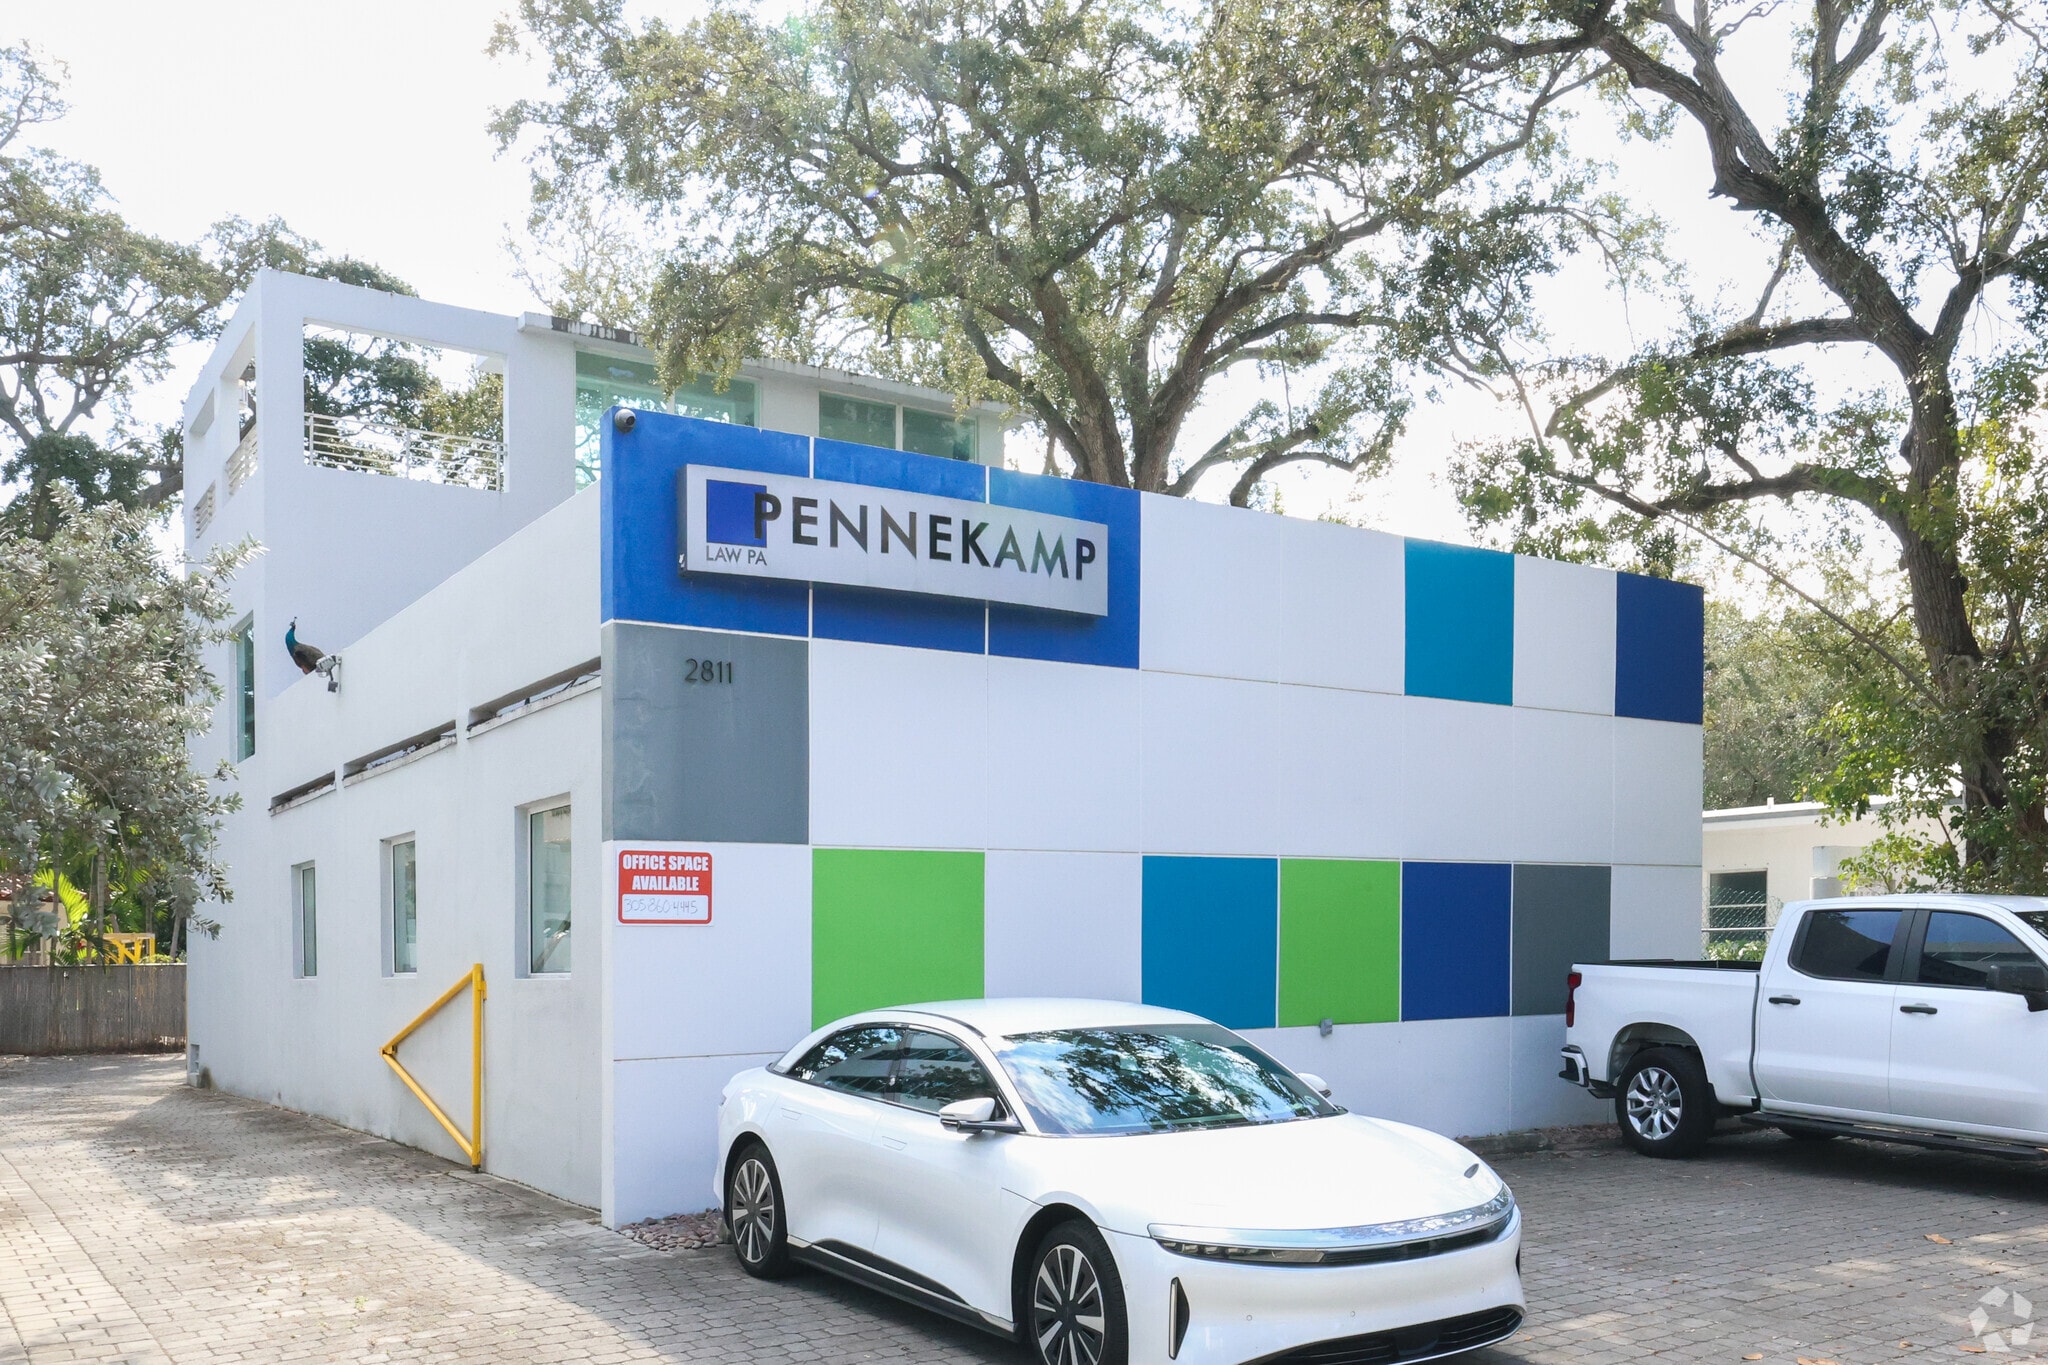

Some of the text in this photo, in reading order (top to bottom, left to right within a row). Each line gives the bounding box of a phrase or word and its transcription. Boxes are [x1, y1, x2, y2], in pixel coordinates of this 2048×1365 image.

[754, 492, 1096, 581] PENNEKAMP
[706, 545, 767, 566] LAW PA
[685, 658, 732, 684] 2811
[623, 854, 709, 872] OFFICE SPACE
[632, 875, 699, 892] AVAILABLE
